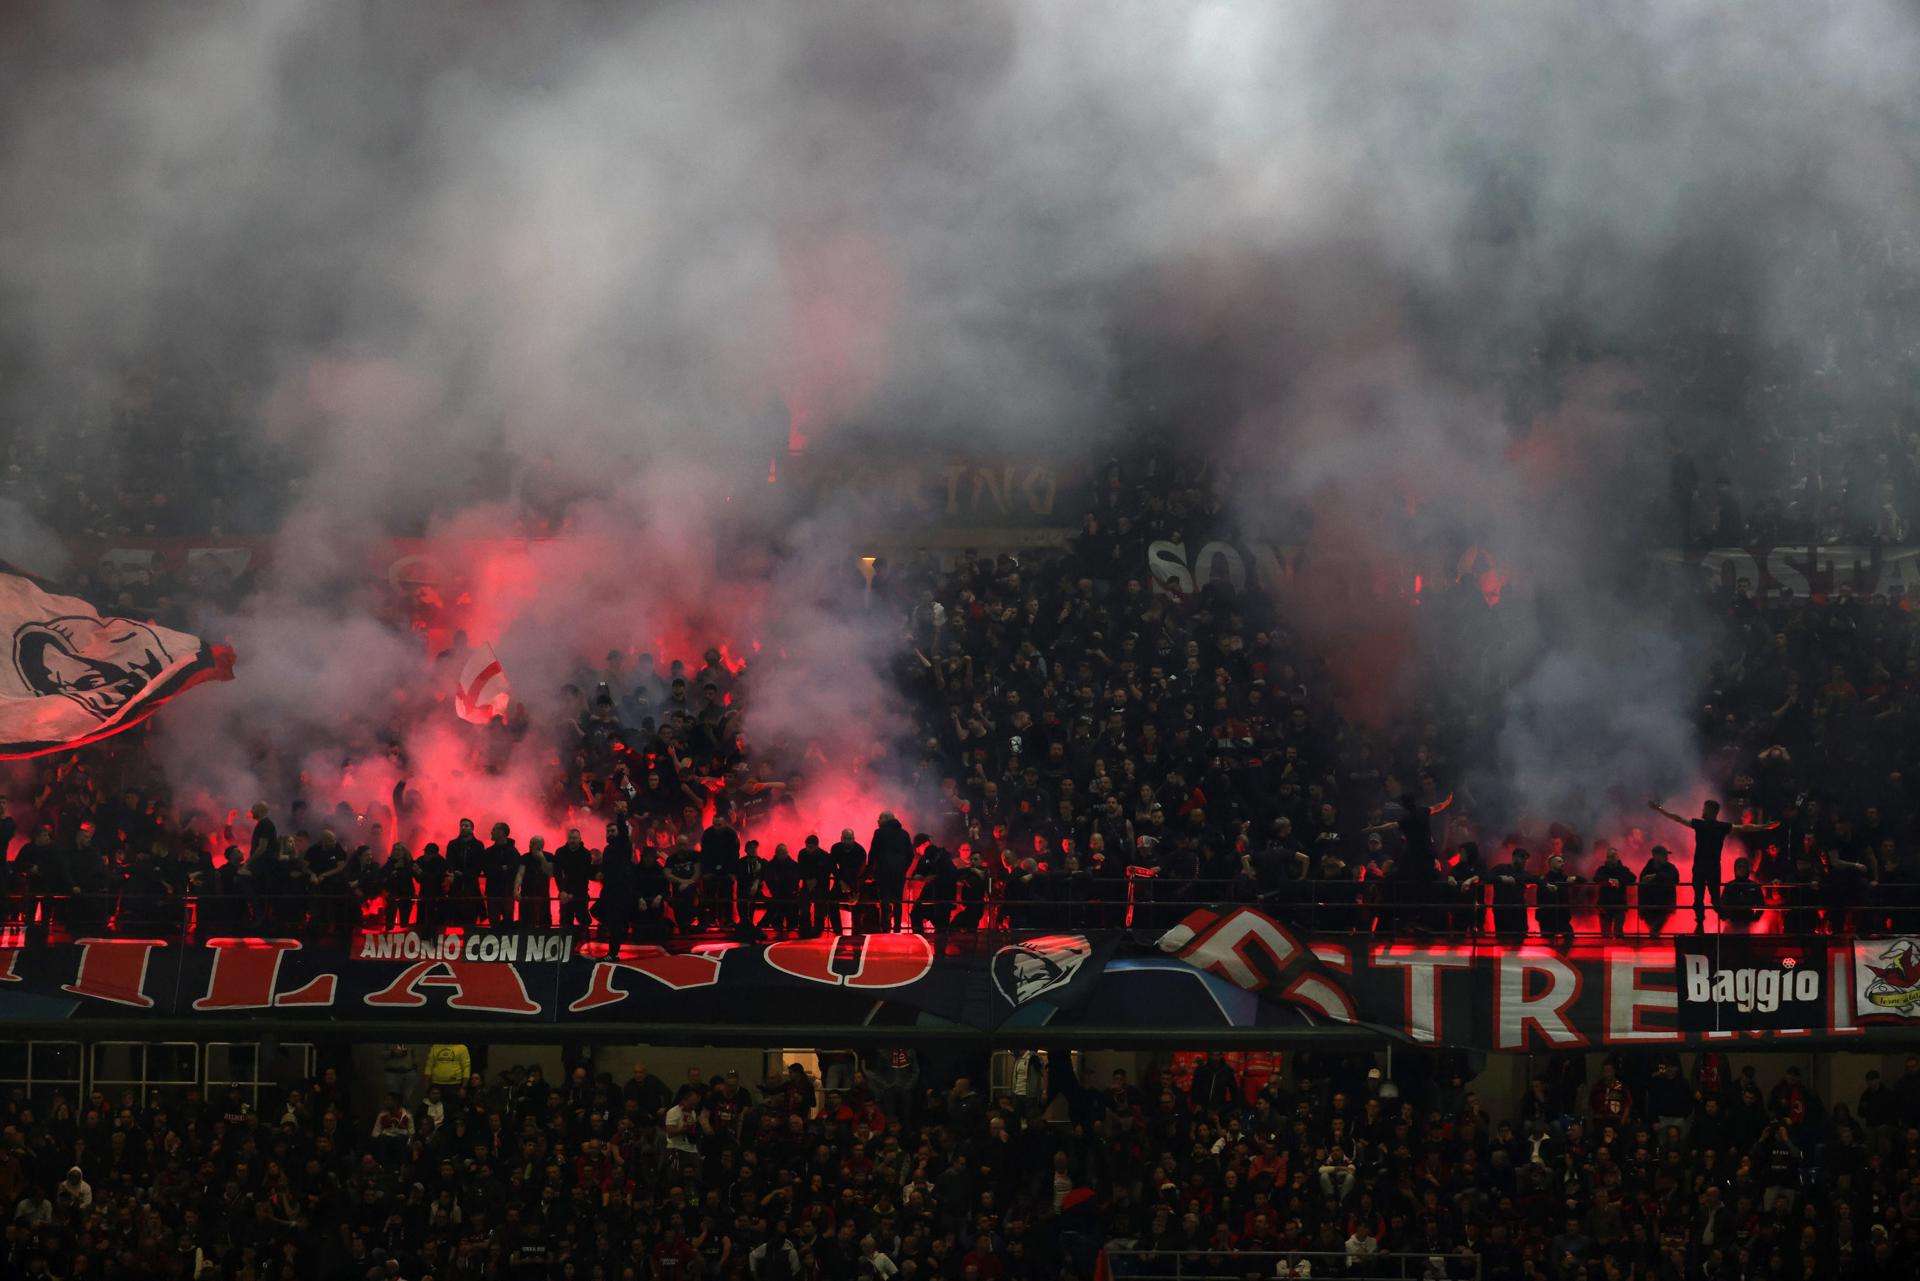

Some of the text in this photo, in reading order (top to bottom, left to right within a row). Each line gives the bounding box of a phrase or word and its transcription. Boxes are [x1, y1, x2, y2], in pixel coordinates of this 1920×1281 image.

[465, 934, 519, 961] CON
[525, 935, 572, 963] NOI
[1684, 953, 1820, 1013] Baggio
